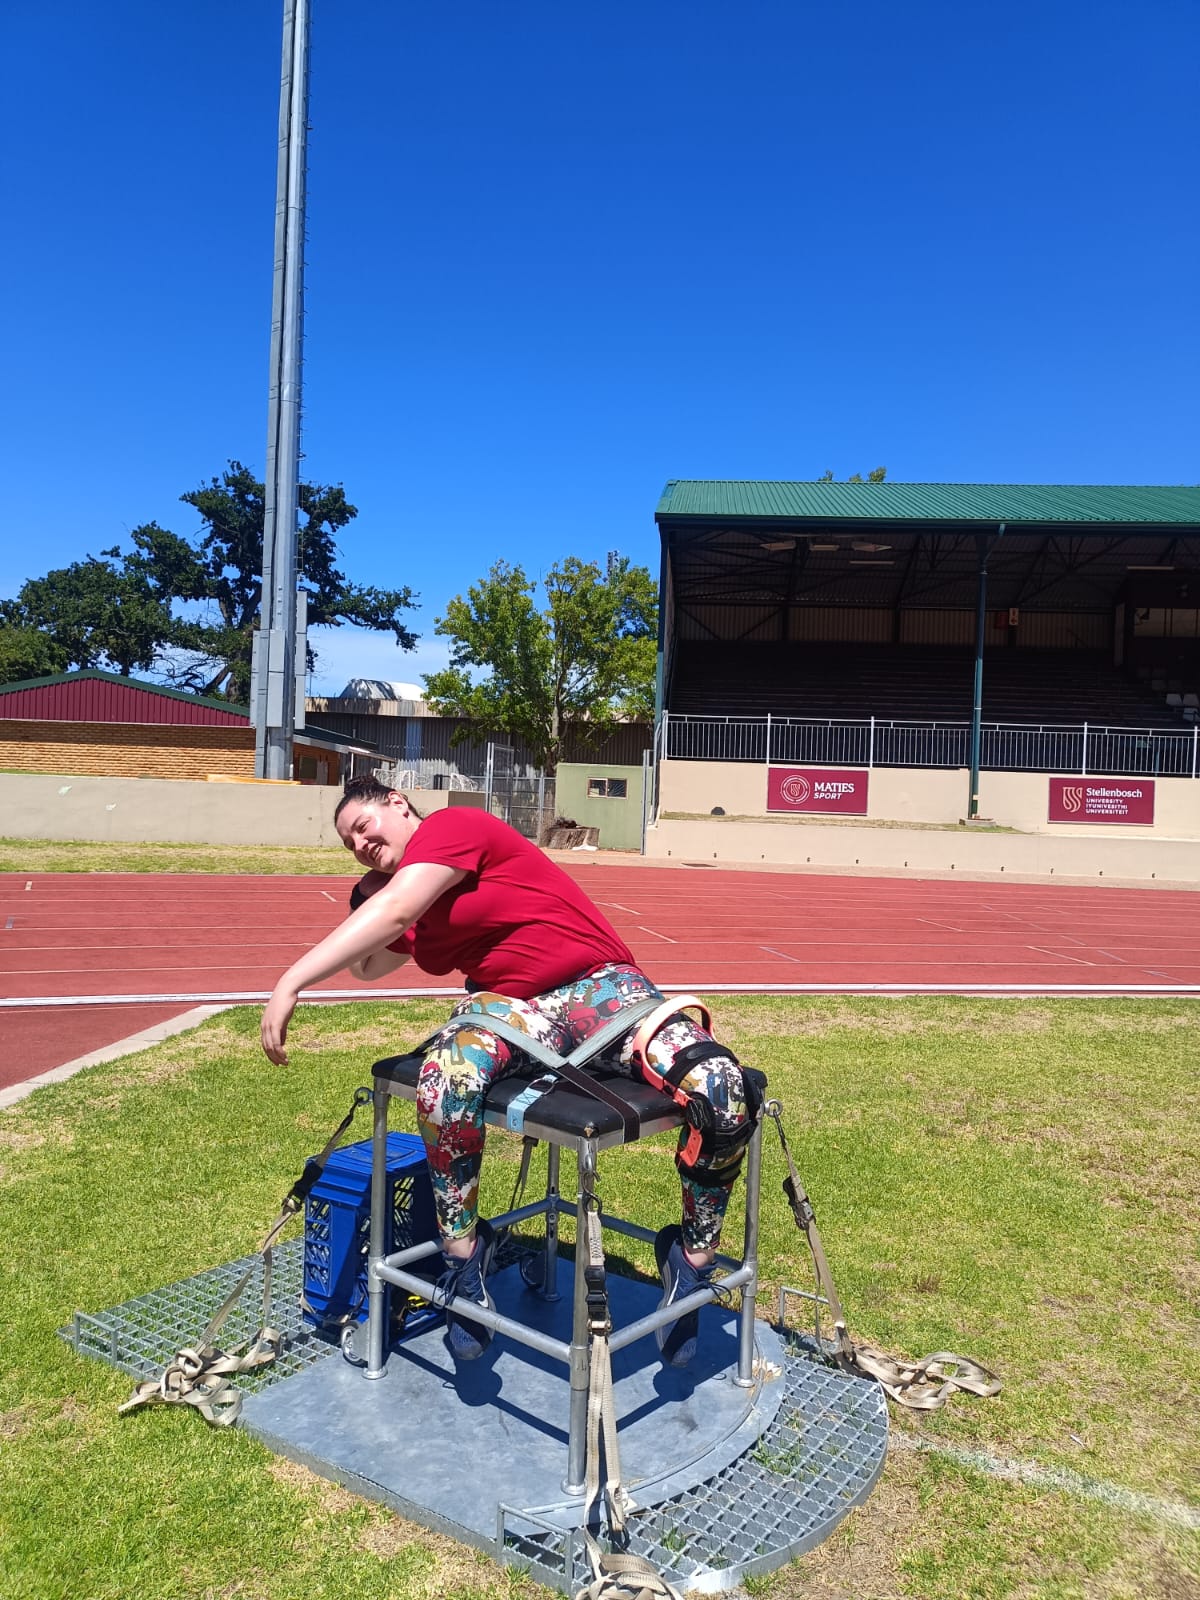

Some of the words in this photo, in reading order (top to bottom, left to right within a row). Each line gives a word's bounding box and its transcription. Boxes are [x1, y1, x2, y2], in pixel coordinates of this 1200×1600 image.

[814, 782, 854, 793] MATIES
[1086, 787, 1142, 798] Stellenbosch
[813, 792, 843, 800] SPORT
